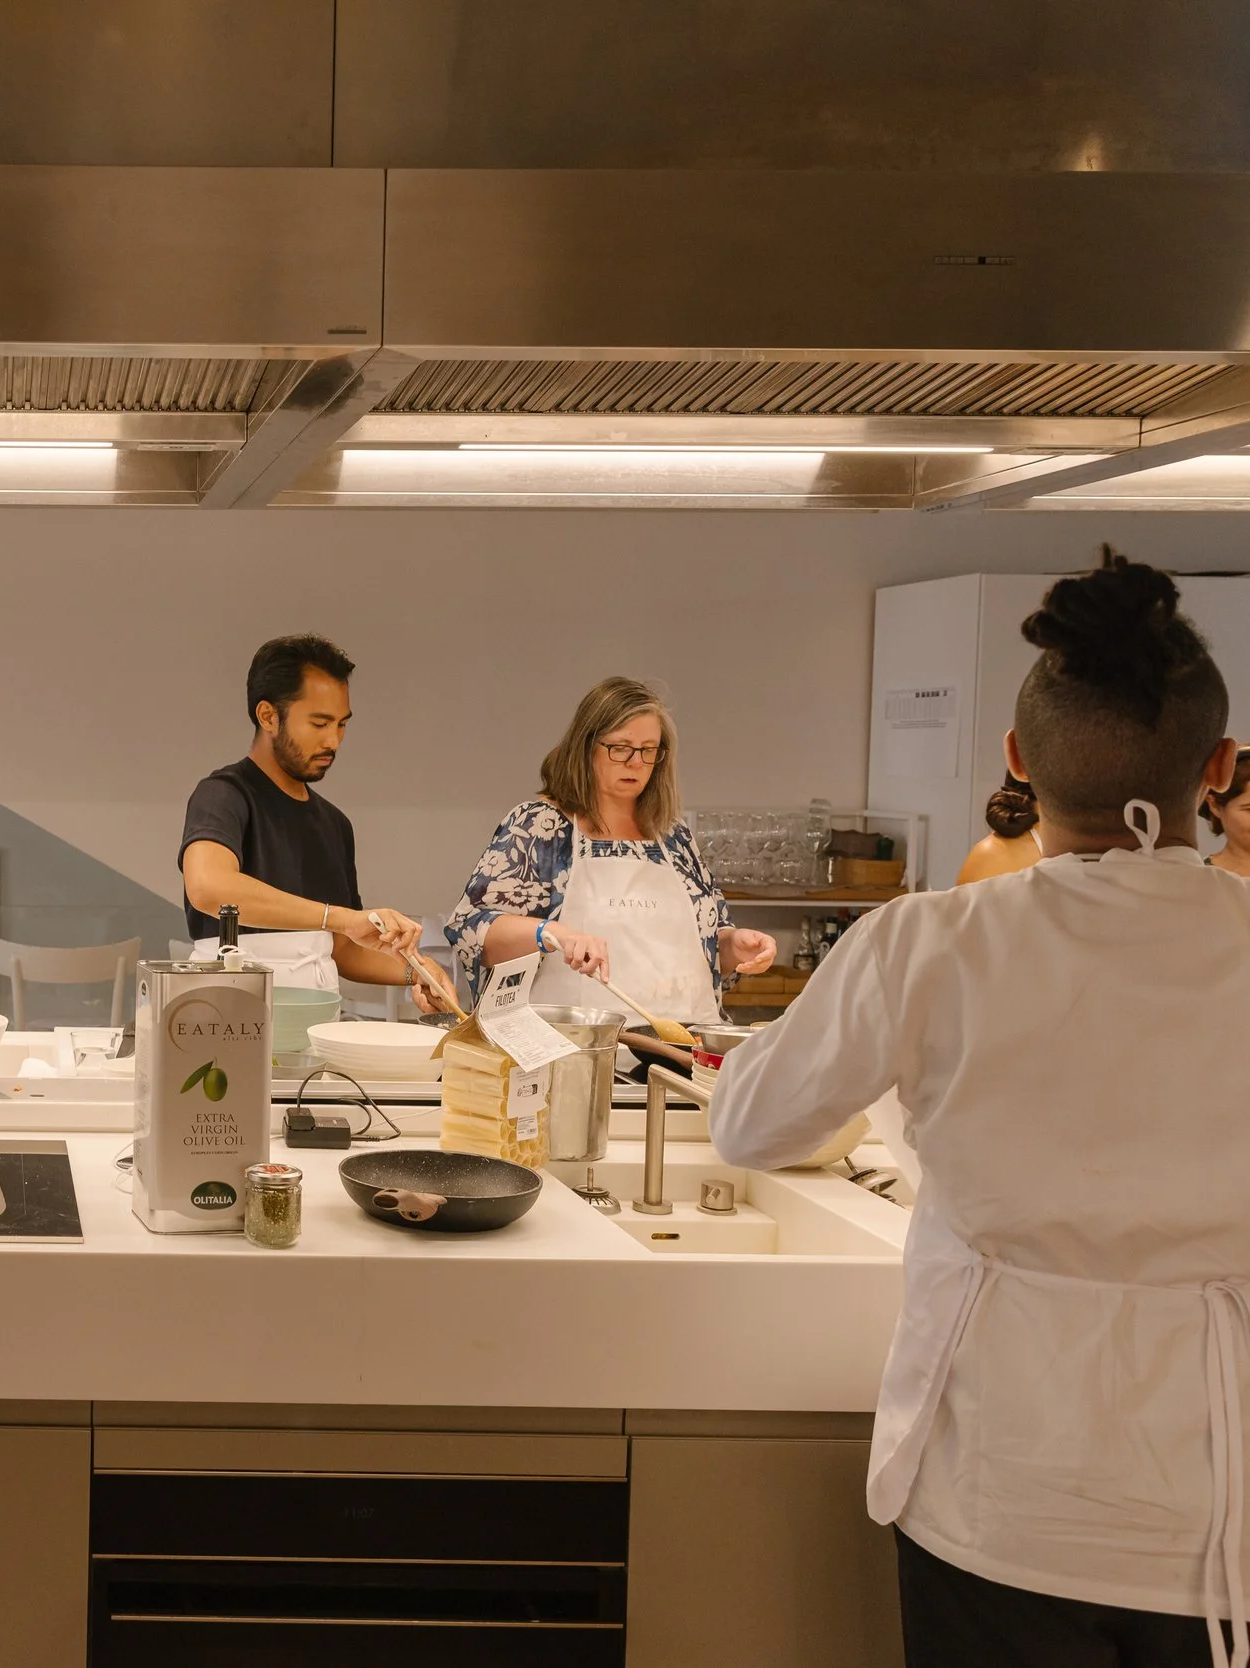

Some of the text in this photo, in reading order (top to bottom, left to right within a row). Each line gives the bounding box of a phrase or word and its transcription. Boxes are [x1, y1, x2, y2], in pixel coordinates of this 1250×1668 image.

[609, 898, 657, 909] EATALY
[495, 991, 516, 1008] FILOTEA
[177, 1022, 265, 1036] EATALY
[196, 1113, 235, 1123] EXTRA
[191, 1124, 238, 1135] VIRGIN
[183, 1136, 246, 1146] OLIVE OIL
[193, 1195, 233, 1205] OLITALIA
